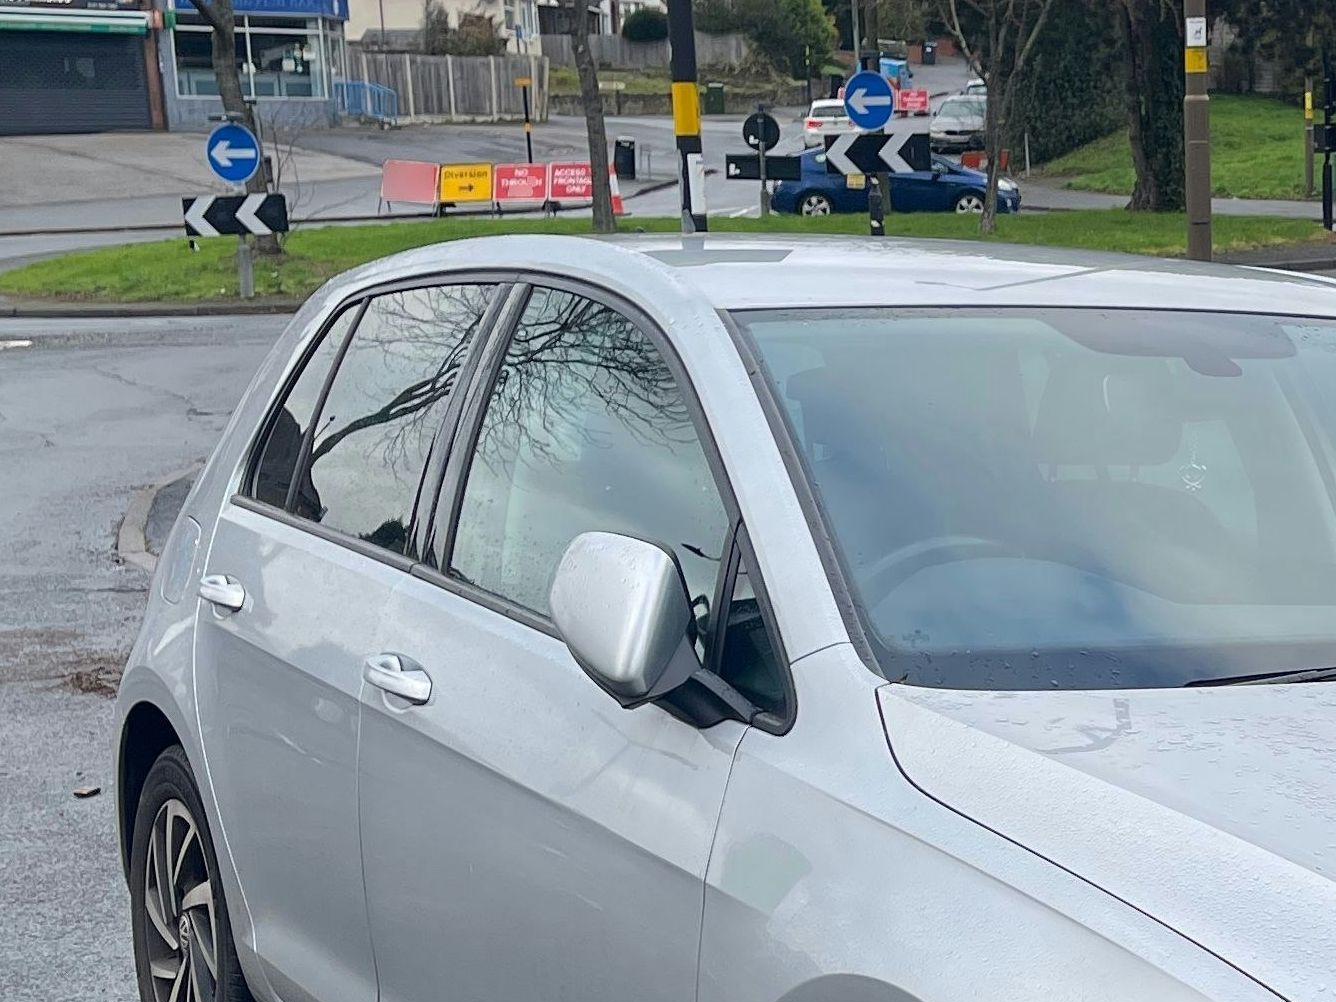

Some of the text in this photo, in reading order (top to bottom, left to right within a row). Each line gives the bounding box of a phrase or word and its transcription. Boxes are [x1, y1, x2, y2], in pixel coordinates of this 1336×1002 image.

[444, 169, 488, 179] Diversion
[514, 168, 529, 177] NO
[553, 177, 592, 185] FRONTAG
